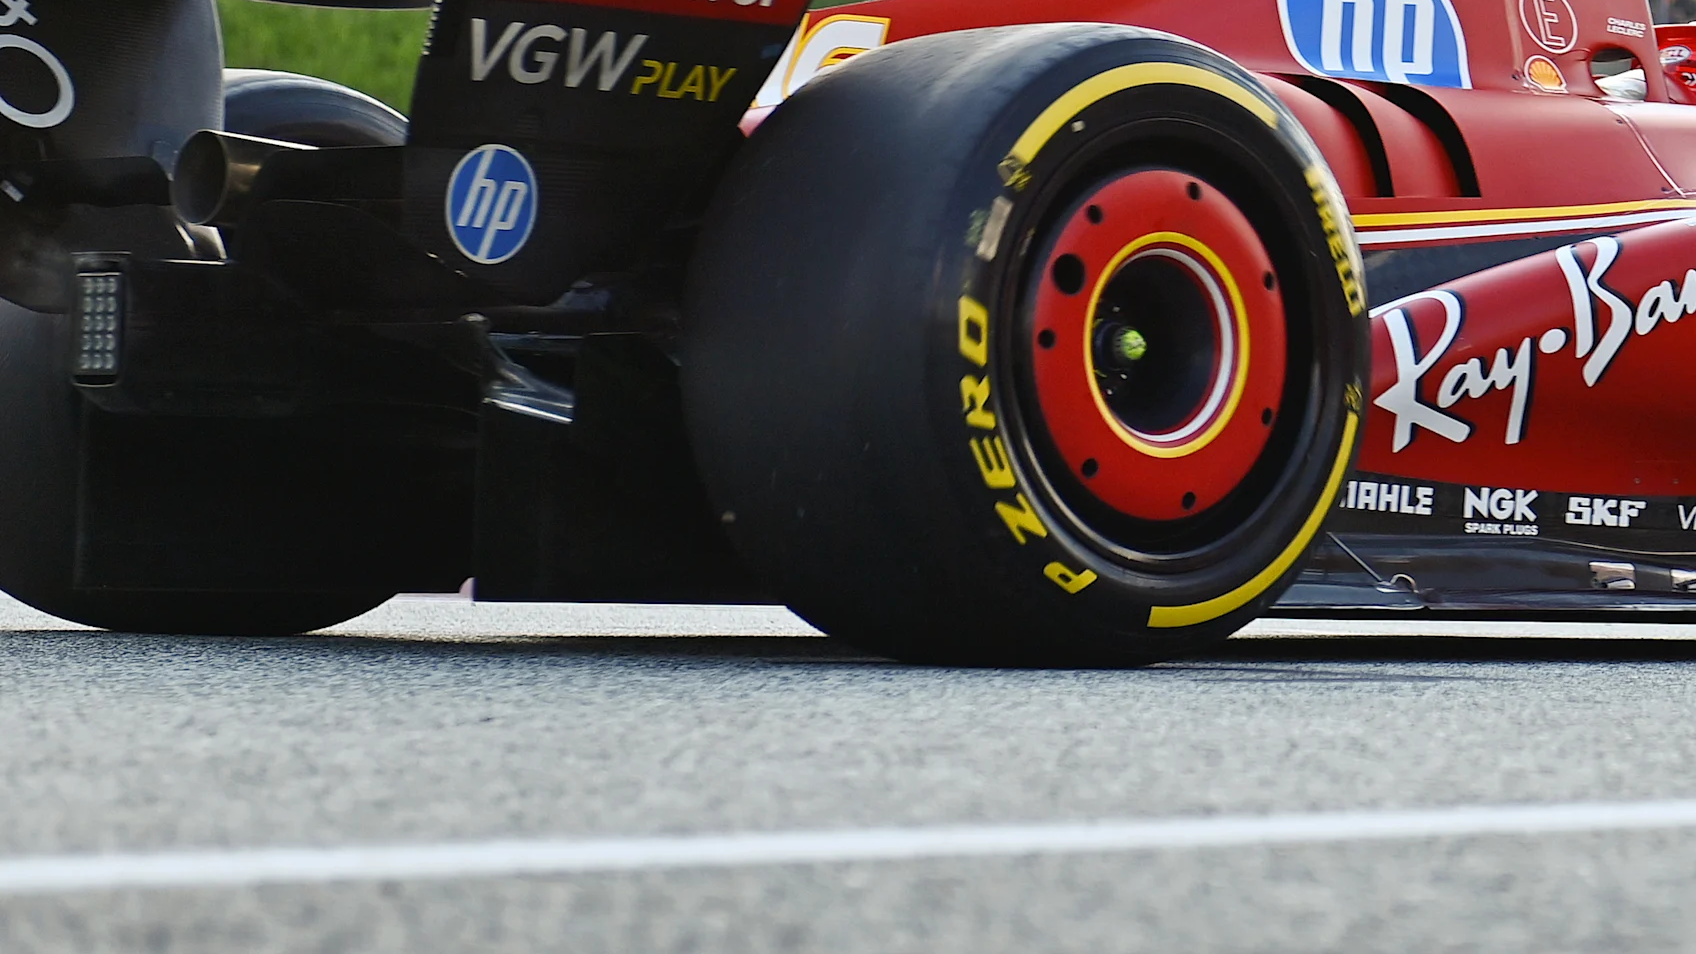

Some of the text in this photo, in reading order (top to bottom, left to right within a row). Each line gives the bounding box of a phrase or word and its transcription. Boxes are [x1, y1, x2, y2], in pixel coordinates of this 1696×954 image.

[471, 18, 649, 91] VGW
[632, 60, 737, 102] PLAY
[460, 148, 529, 264] hp
[958, 295, 1098, 594] P ZERO
[1462, 487, 1540, 523] NGK
[1464, 522, 1540, 536] SPARK PLUGS
[1565, 496, 1647, 528] SKF
